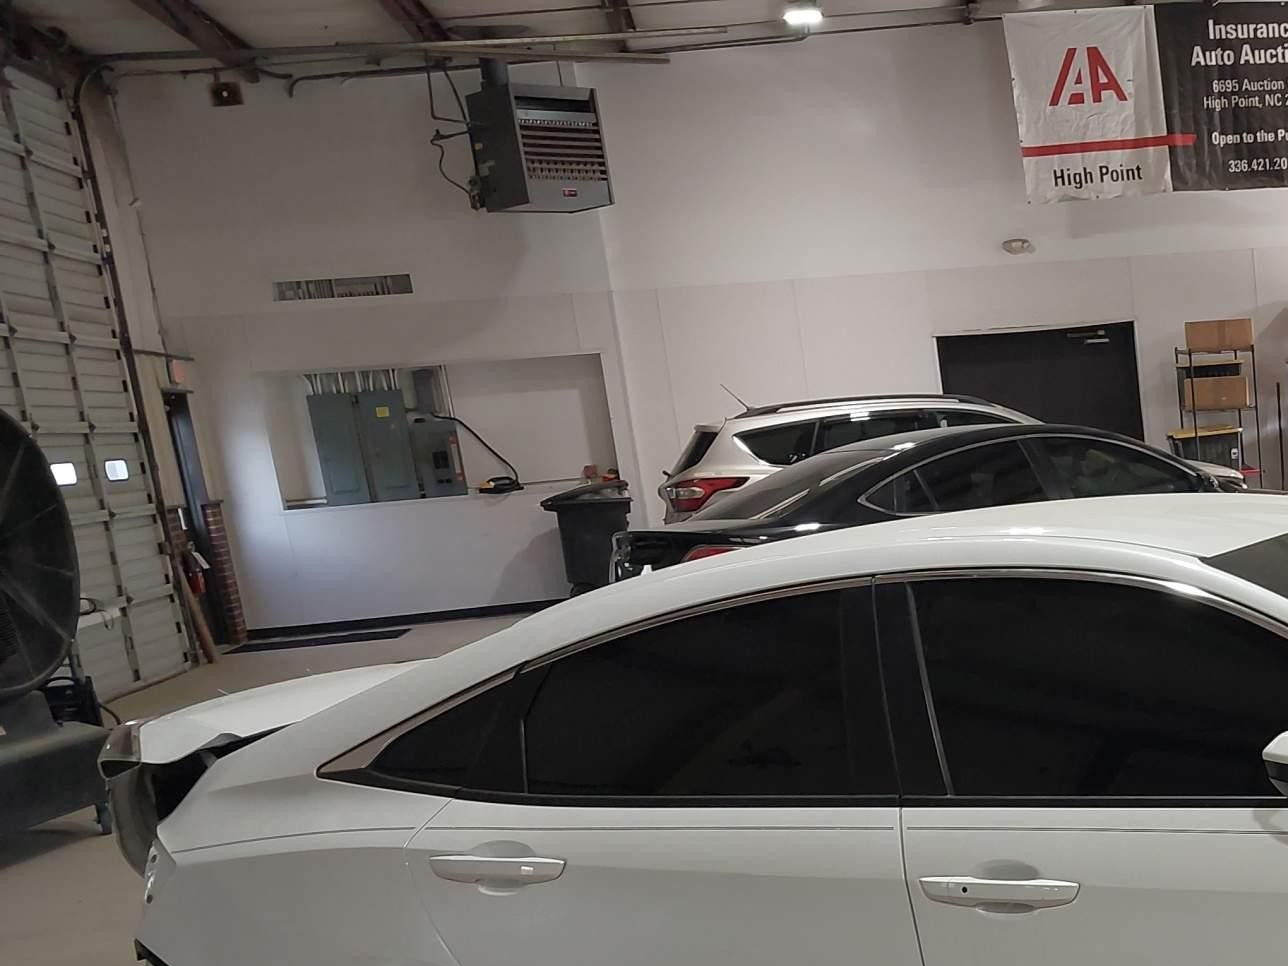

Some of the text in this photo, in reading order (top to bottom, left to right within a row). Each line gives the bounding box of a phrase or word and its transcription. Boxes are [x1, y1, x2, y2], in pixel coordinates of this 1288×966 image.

[1191, 45, 1235, 66] Auto
[1212, 79, 1239, 92] 6695
[1242, 78, 1285, 91] Auction
[1203, 96, 1229, 111] High
[1231, 95, 1263, 108] Point,
[1265, 94, 1282, 106] NC
[1212, 131, 1241, 148] Open
[1242, 132, 1255, 143] to
[1256, 130, 1275, 142] the
[1053, 164, 1143, 189] High Point
